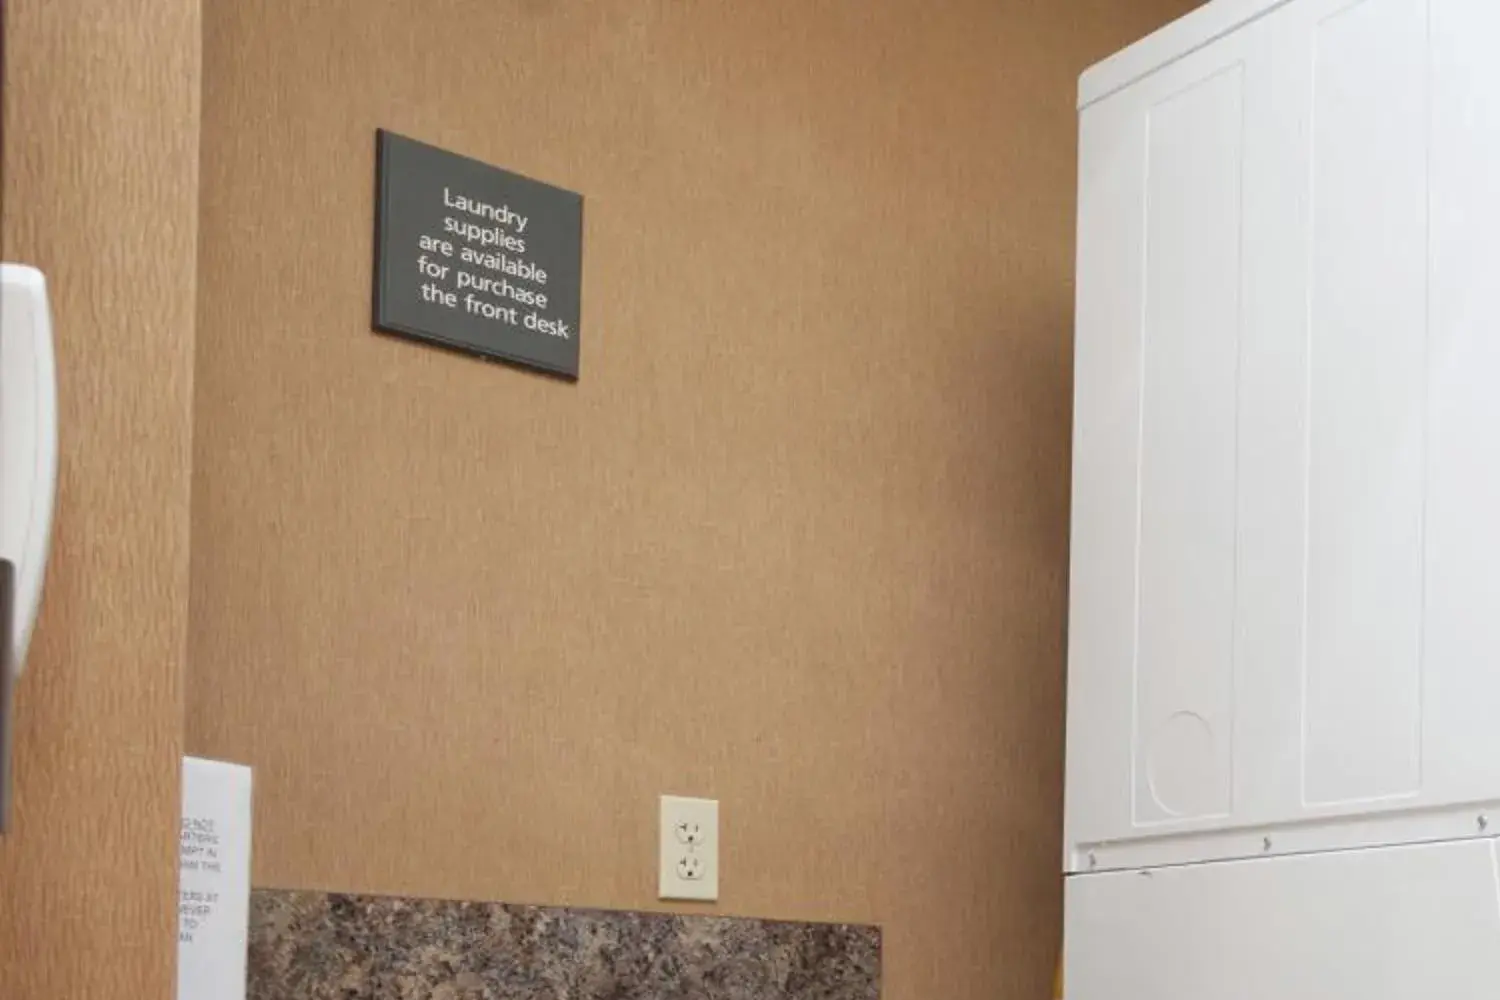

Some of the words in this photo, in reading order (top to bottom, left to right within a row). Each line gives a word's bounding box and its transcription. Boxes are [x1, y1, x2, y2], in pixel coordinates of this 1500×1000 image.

[443, 187, 529, 232] Laundry
[419, 235, 453, 257] are
[460, 245, 548, 285] available
[443, 216, 526, 254] supplies
[417, 256, 449, 281] for
[457, 270, 548, 309] purchase
[421, 283, 457, 308] the
[464, 293, 518, 326] front
[523, 312, 570, 340] desk
